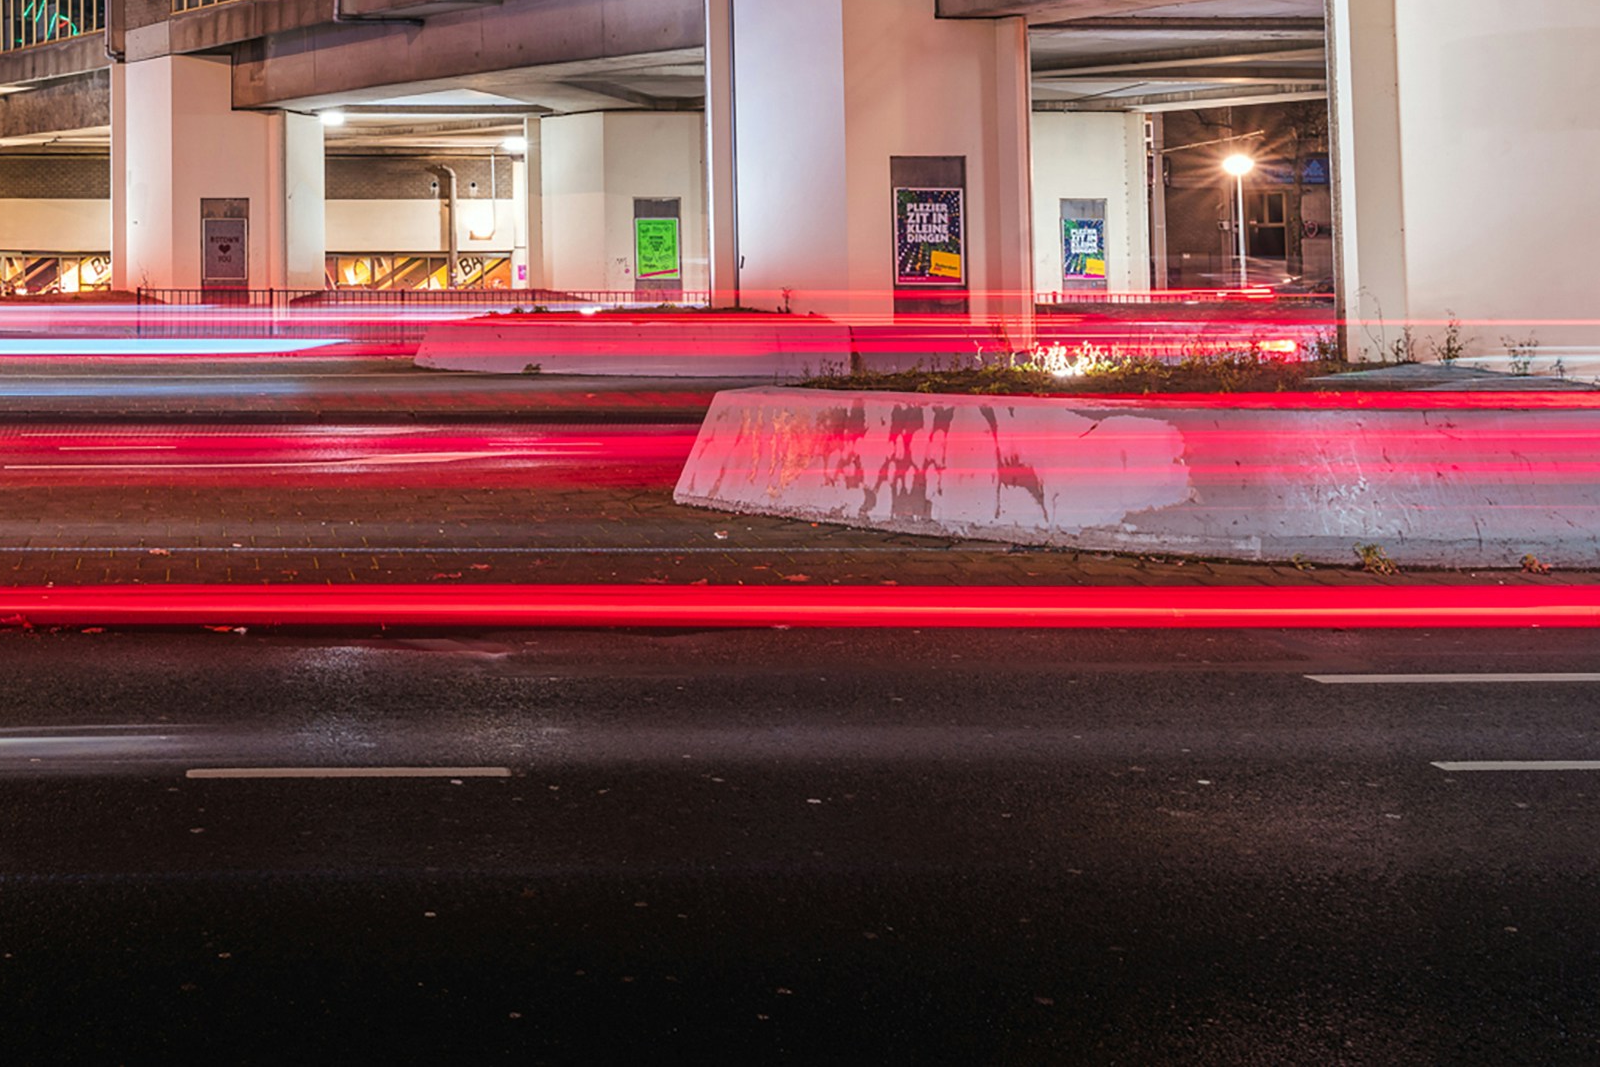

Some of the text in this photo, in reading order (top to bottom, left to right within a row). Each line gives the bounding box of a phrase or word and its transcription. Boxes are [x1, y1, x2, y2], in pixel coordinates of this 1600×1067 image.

[906, 203, 948, 212] PLEZIER
[907, 213, 948, 224] ZIT IN
[907, 224, 949, 234] KLEINE
[906, 234, 949, 243] DINGEN
